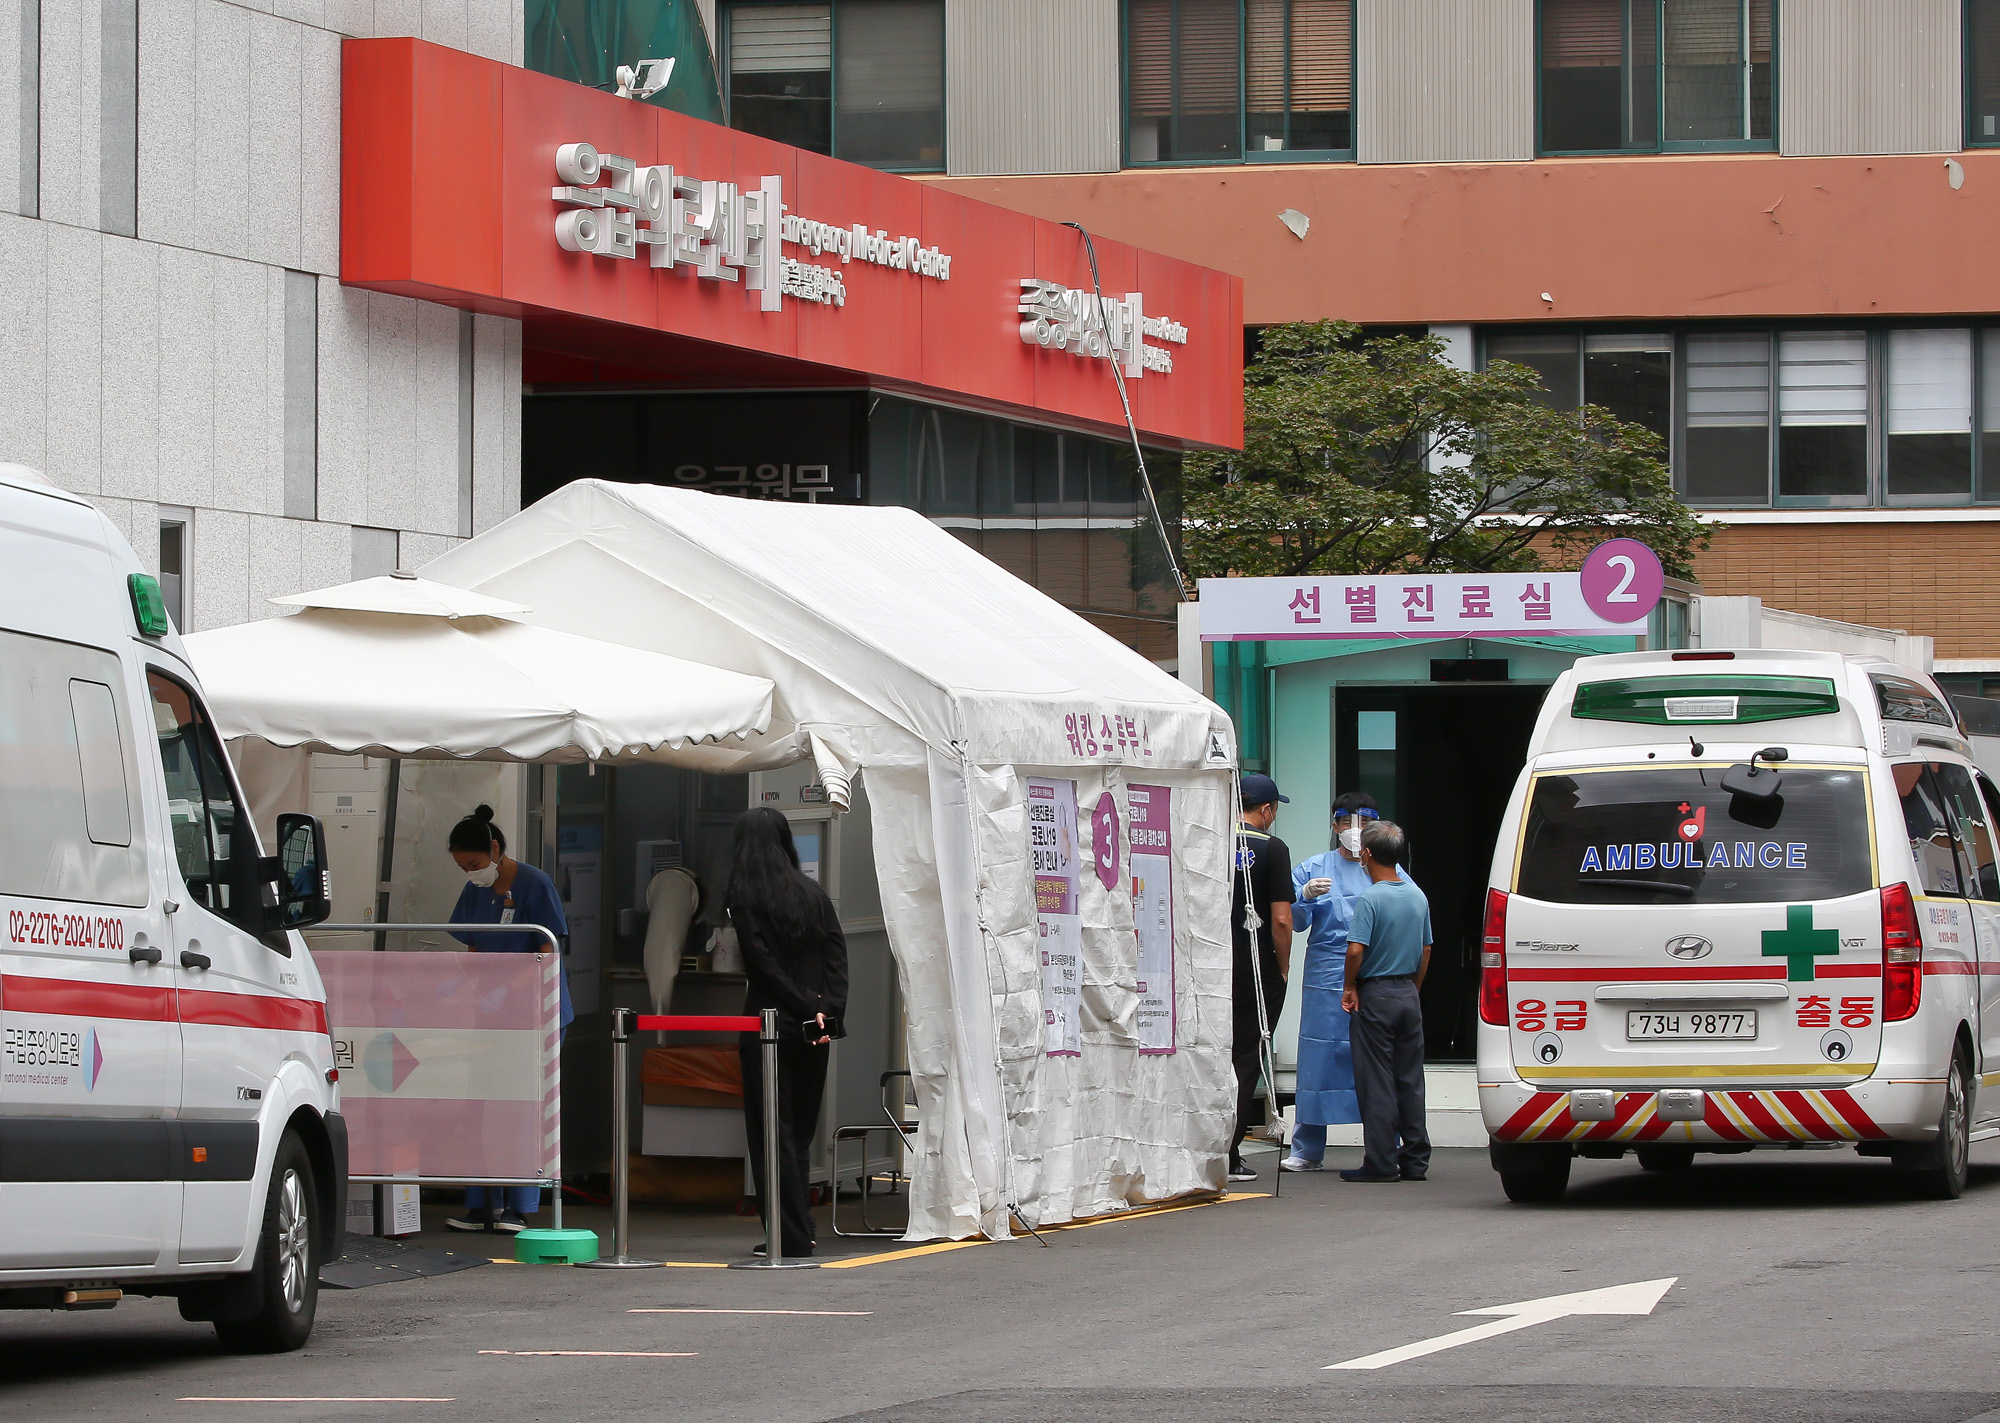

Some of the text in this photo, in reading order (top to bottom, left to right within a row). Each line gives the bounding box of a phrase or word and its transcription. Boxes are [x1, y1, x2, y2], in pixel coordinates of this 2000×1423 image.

[552, 142, 781, 312] 응급의료센터
[781, 204, 952, 281] Emergency Medical Center
[1018, 278, 1143, 378] 중증외상센터
[1605, 554, 1639, 603] 2
[1287, 582, 1553, 623] 선별진료실
[1030, 803, 1055, 822] 선별진료실
[1032, 825, 1056, 846] 코로나19
[1101, 813, 1115, 868] 3
[1579, 840, 1808, 873] AMBULANCE
[9, 909, 124, 950] 02-2276-2024/2100
[1530, 939, 1580, 952] Starex
[1840, 937, 1867, 948] VGT
[1515, 999, 1588, 1032] 응급
[1639, 1014, 1745, 1035] 73너 9877
[1795, 995, 1875, 1029] 출동
[5, 1028, 80, 1067] 국립중앙의료원
[4, 1072, 69, 1086] national medical center
